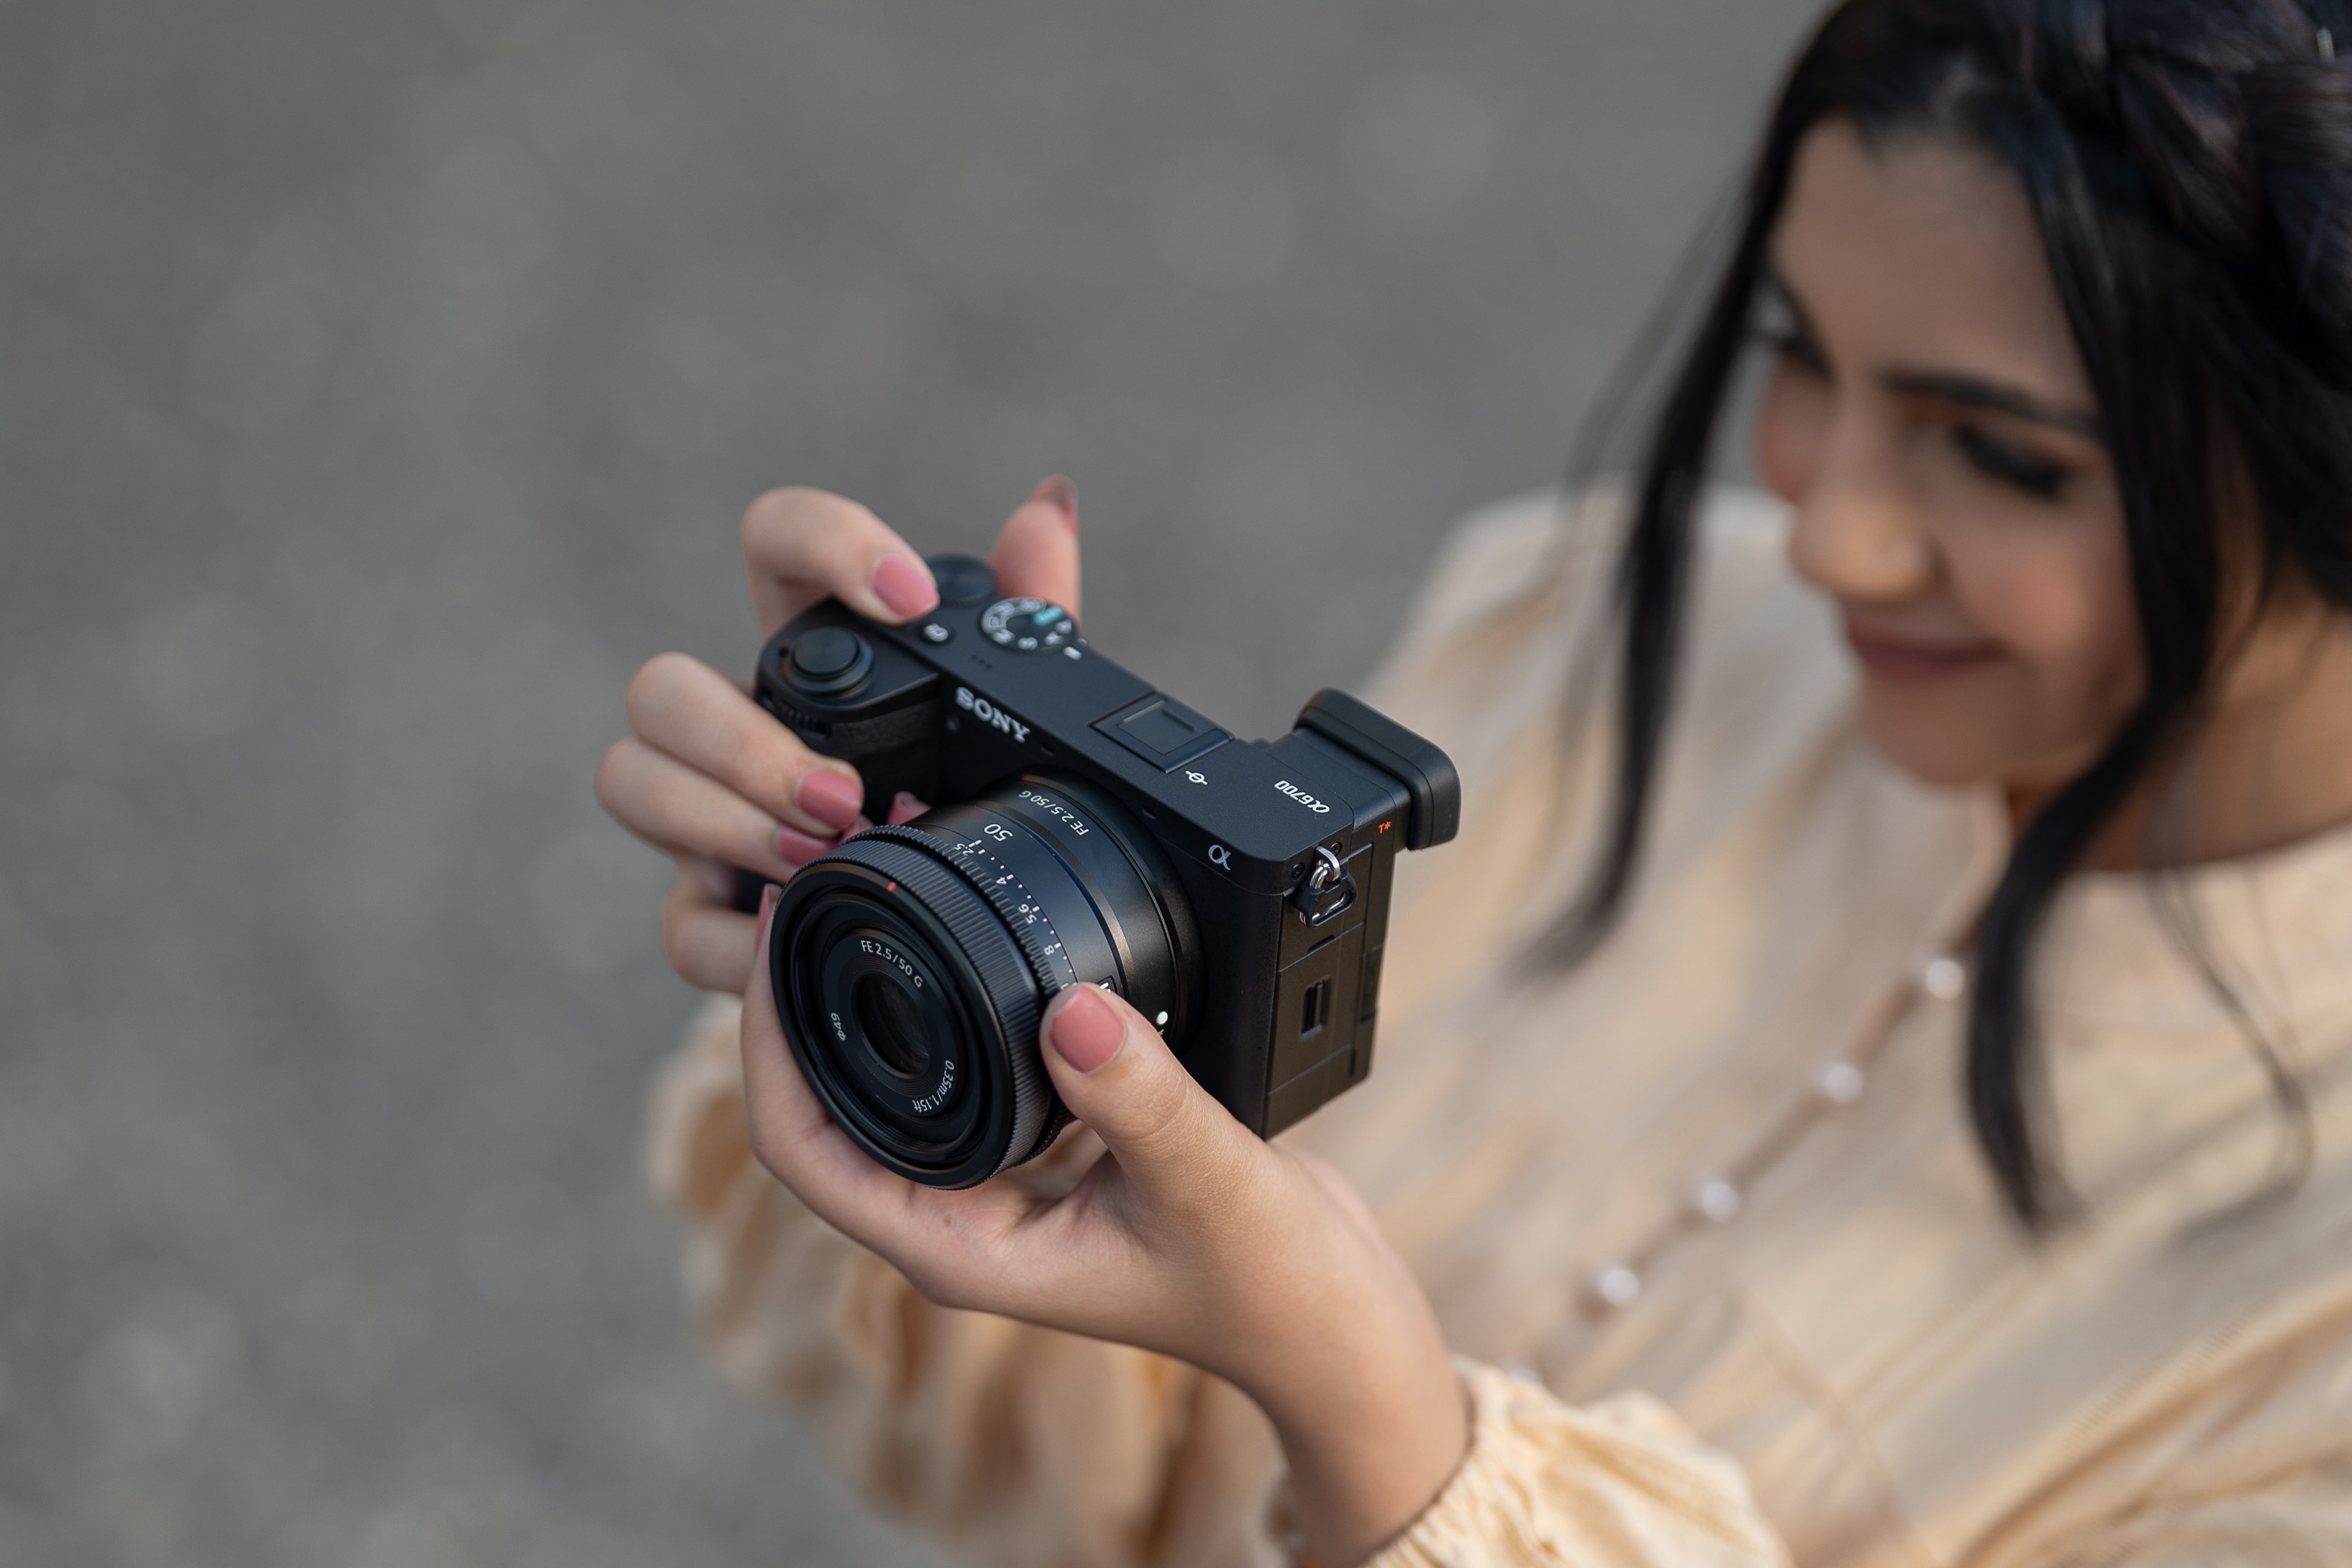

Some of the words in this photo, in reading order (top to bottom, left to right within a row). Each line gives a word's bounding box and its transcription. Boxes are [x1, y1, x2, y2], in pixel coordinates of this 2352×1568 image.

[956, 687, 1030, 743] SONY
[1030, 795, 1074, 822] 2.5/50
[984, 823, 1013, 841] 50
[1070, 820, 1089, 836] FE
[954, 843, 975, 856] 2.5
[1018, 903, 1037, 924] 5.6
[1043, 944, 1055, 956] 8
[860, 940, 874, 953] FE
[914, 976, 923, 988] G
